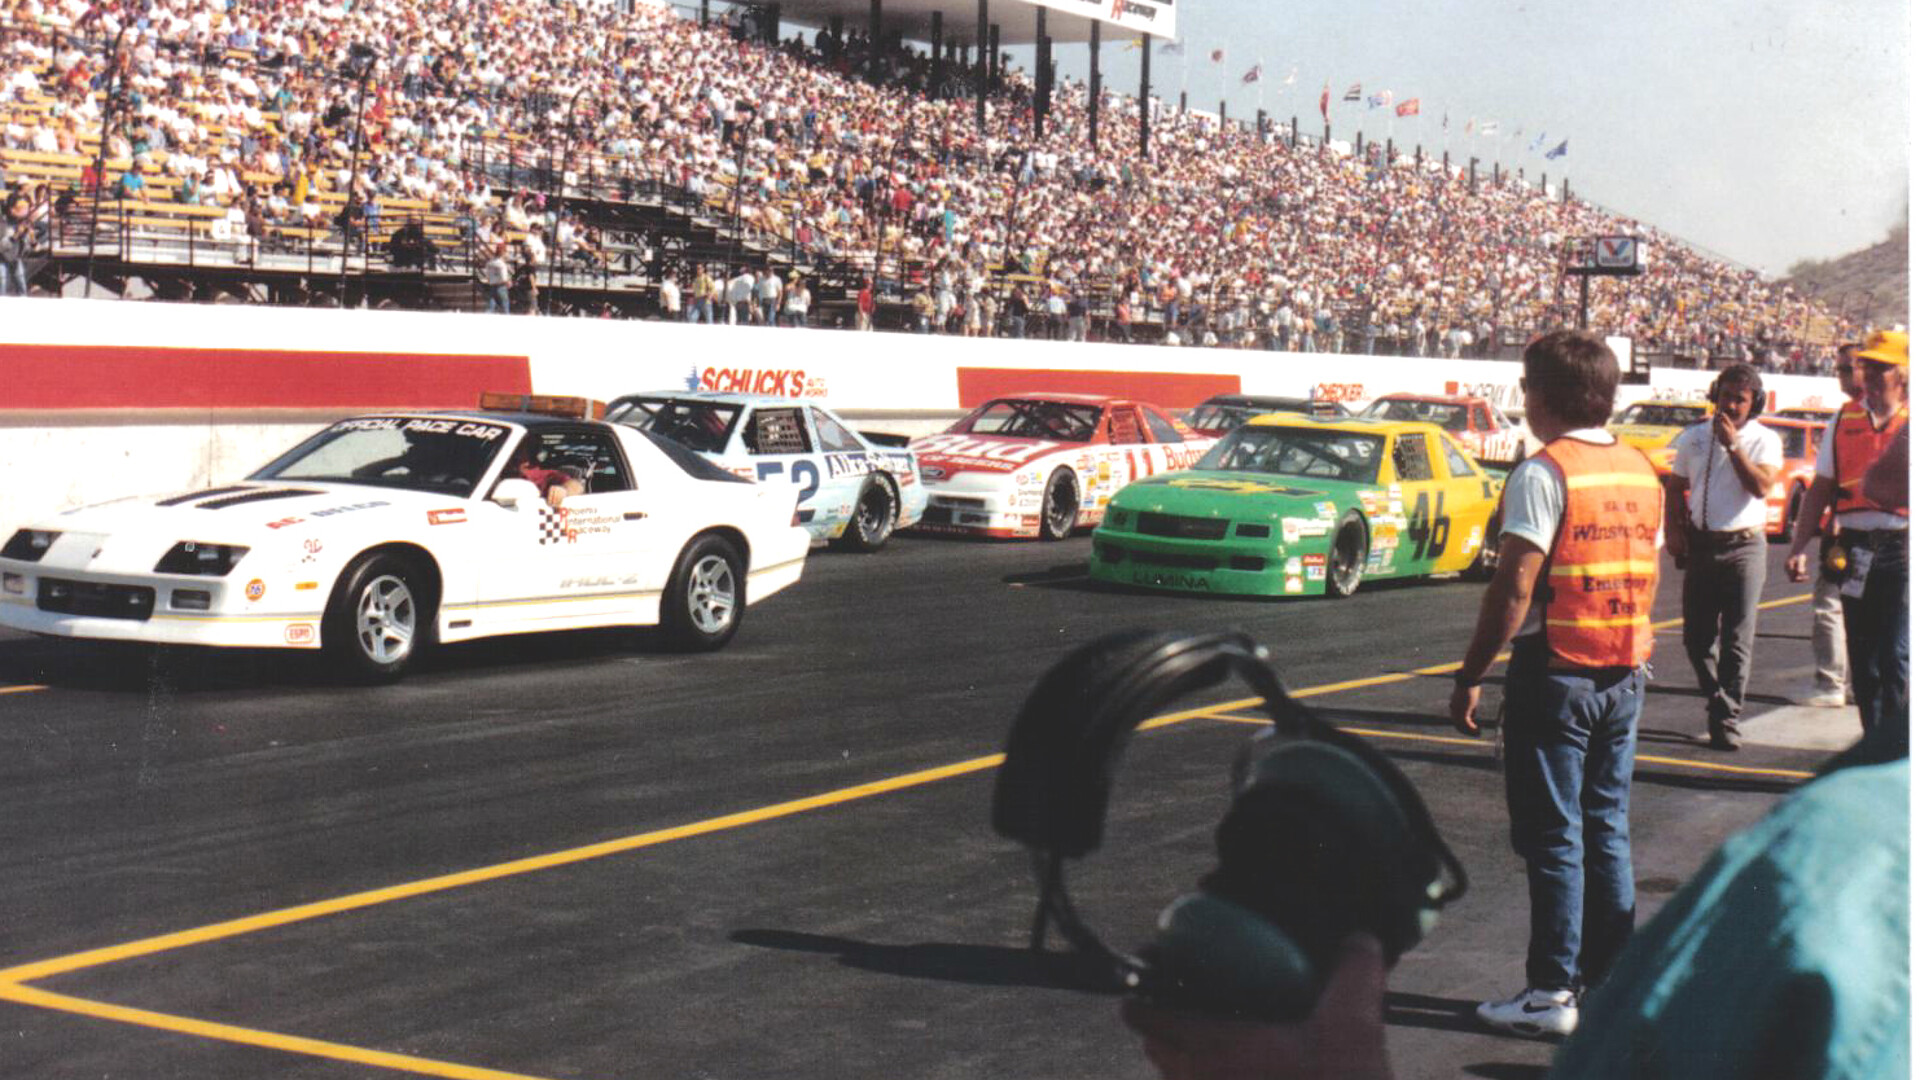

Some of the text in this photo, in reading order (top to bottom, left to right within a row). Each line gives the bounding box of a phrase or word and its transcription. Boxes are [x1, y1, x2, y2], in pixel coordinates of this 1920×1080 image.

[701, 366, 805, 398] SCHUCK'S
[402, 419, 458, 434] PACE
[455, 422, 503, 441] CAR
[1408, 490, 1451, 561] 46
[1133, 571, 1210, 590] LUMINA
